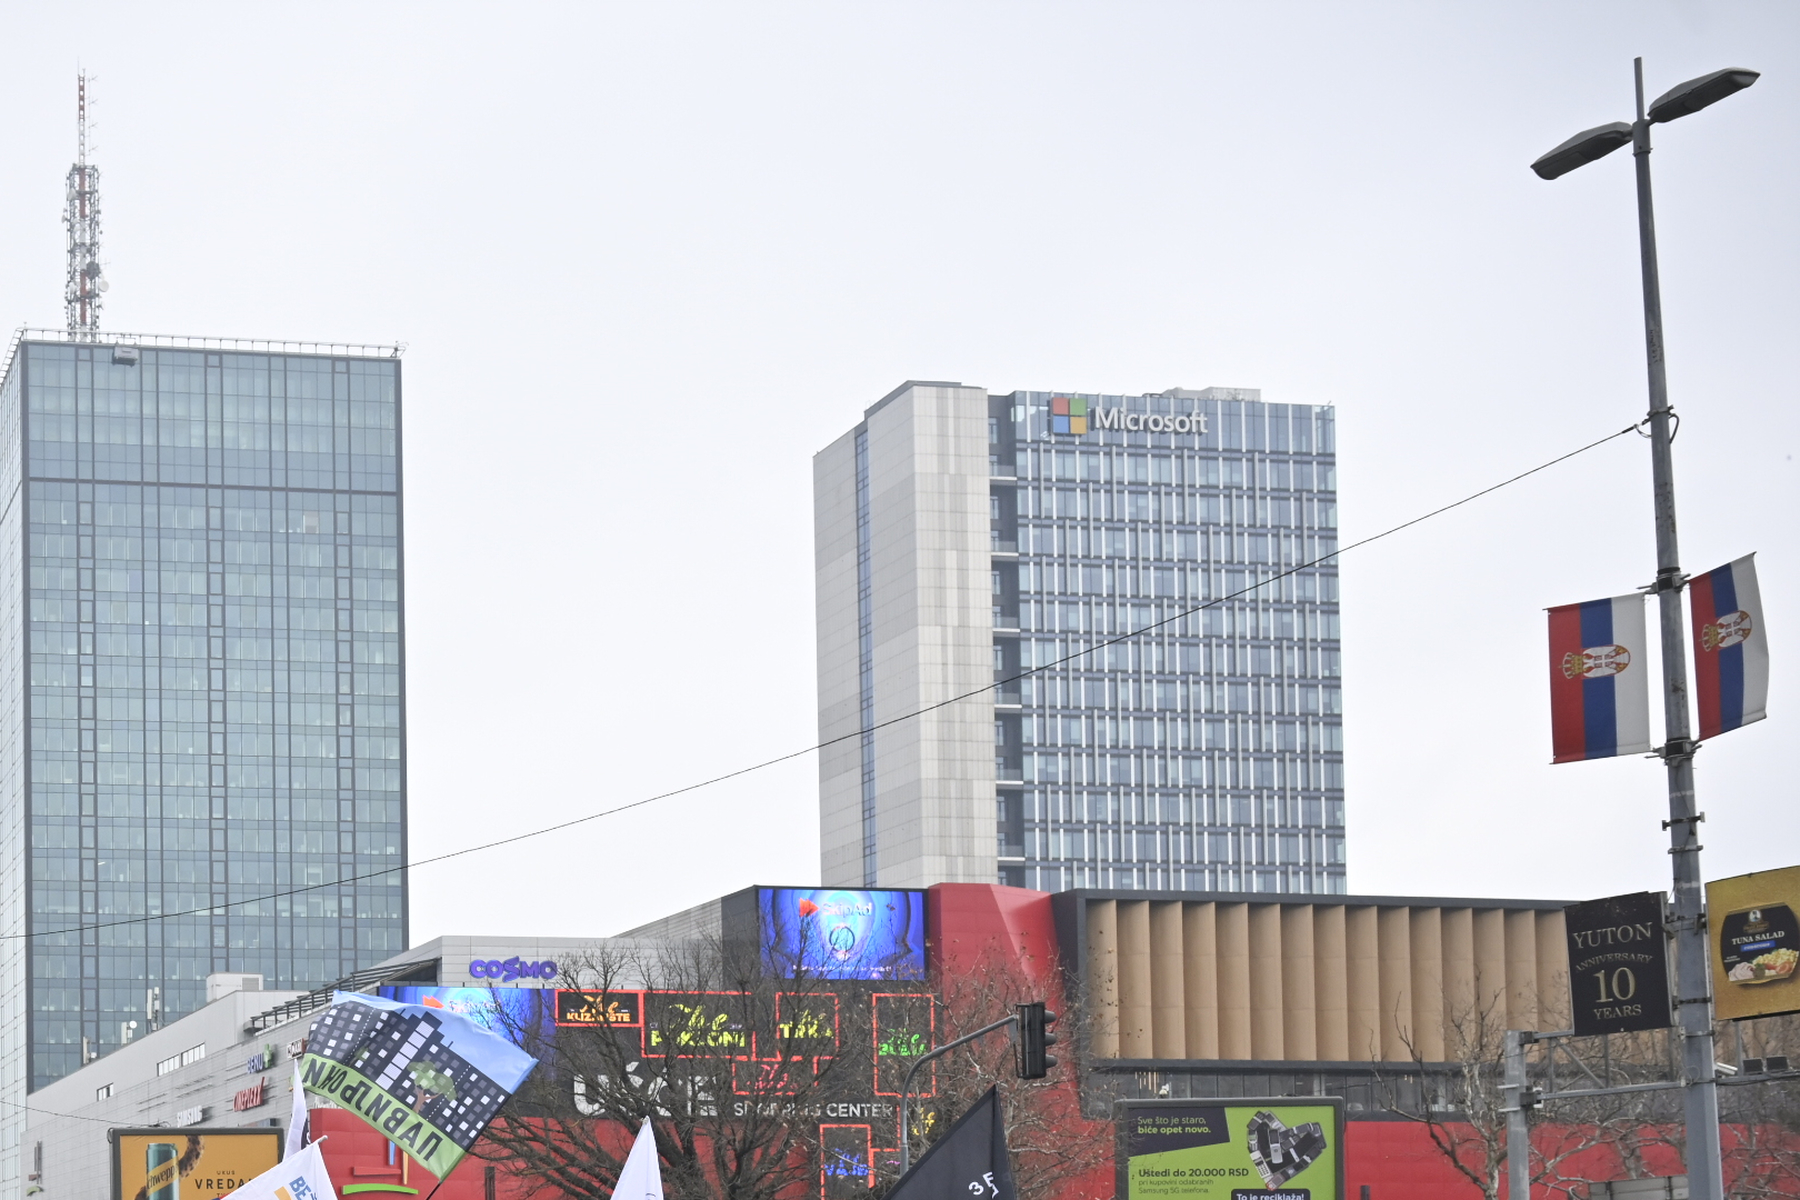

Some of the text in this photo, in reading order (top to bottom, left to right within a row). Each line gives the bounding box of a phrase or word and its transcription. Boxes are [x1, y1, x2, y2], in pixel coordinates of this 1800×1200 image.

[1095, 406, 1208, 433] Microsoft
[1573, 922, 1653, 949] YUTON
[1732, 930, 1785, 945] TUNA SALAD
[469, 955, 557, 983] COSMO
[1575, 952, 1653, 971] ANNIVERSARY
[1593, 967, 1636, 1003] 10
[1593, 1004, 1642, 1020] YEARS
[826, 1103, 893, 1118] CENTER
[1137, 1116, 1207, 1127] Sve što je staro,
[1137, 1126, 1158, 1134] biće
[1160, 1126, 1183, 1135] opet
[1138, 1168, 1249, 1177] Uštedi do 20.000 RSD
[195, 1178, 252, 1189] VREDA
[1138, 1179, 1148, 1187] pri
